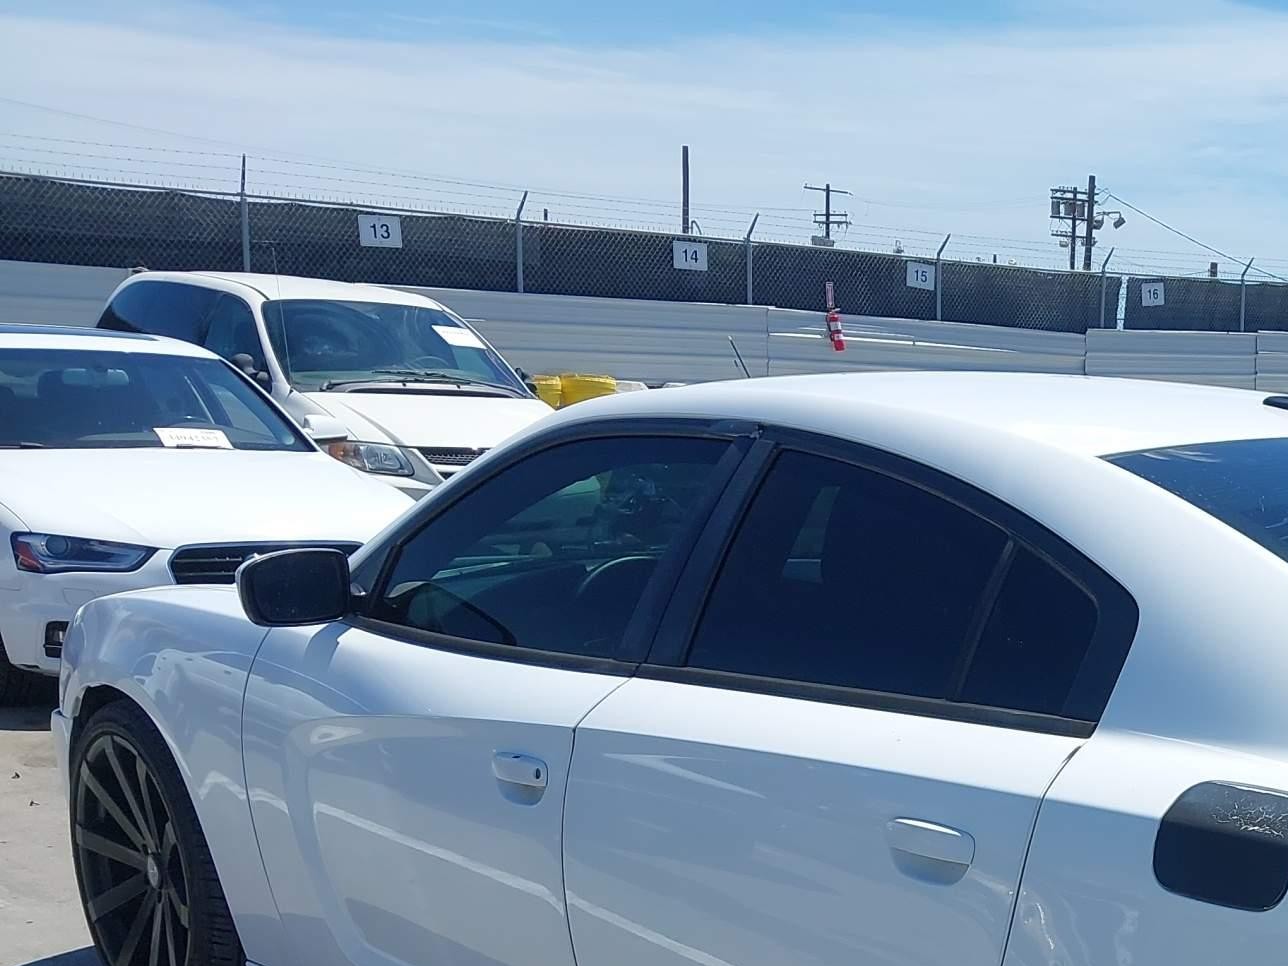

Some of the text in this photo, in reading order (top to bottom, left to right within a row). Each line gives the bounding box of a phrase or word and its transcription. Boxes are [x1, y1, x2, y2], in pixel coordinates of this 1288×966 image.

[369, 223, 391, 240] 13
[682, 248, 699, 263] 14
[914, 269, 928, 283] 15
[1147, 288, 1159, 300] 16
